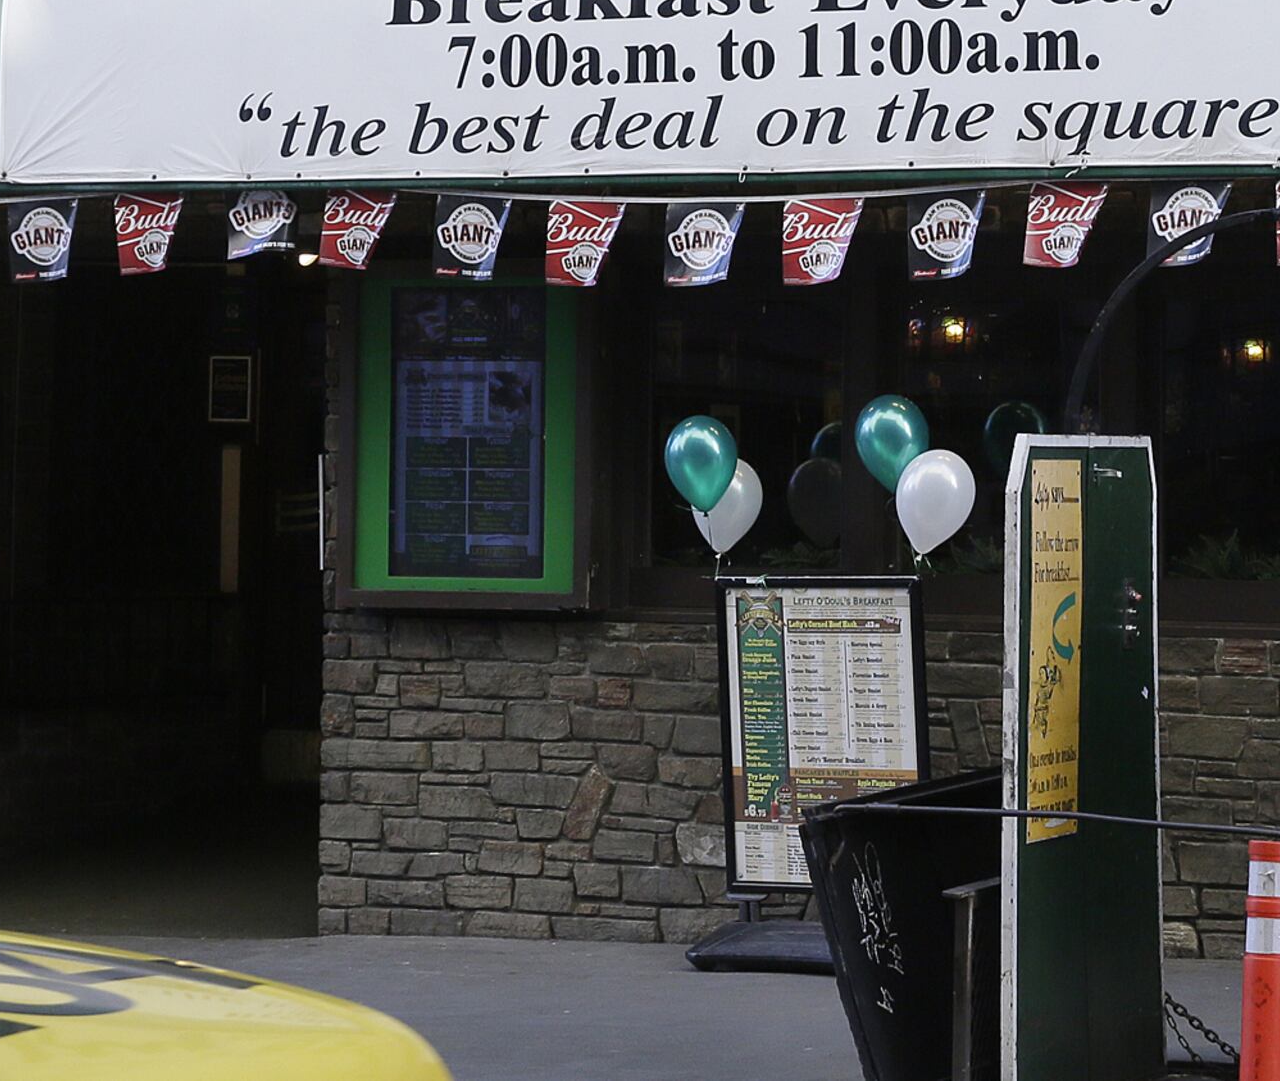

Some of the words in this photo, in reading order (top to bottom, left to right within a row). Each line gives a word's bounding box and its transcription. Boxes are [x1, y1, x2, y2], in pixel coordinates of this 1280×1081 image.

[448, 32, 697, 89] 7:00a.m.
[717, 29, 776, 82] to
[798, 18, 1101, 79] 11:00a.m.
[408, 102, 550, 155] best
[570, 94, 724, 151] deal
[756, 107, 847, 147] on
[876, 87, 995, 143] the
[232, 200, 295, 227] GIANTS
[15, 227, 68, 250] GIANTS
[442, 224, 500, 248] GIANTS
[672, 230, 732, 253] GIANTS
